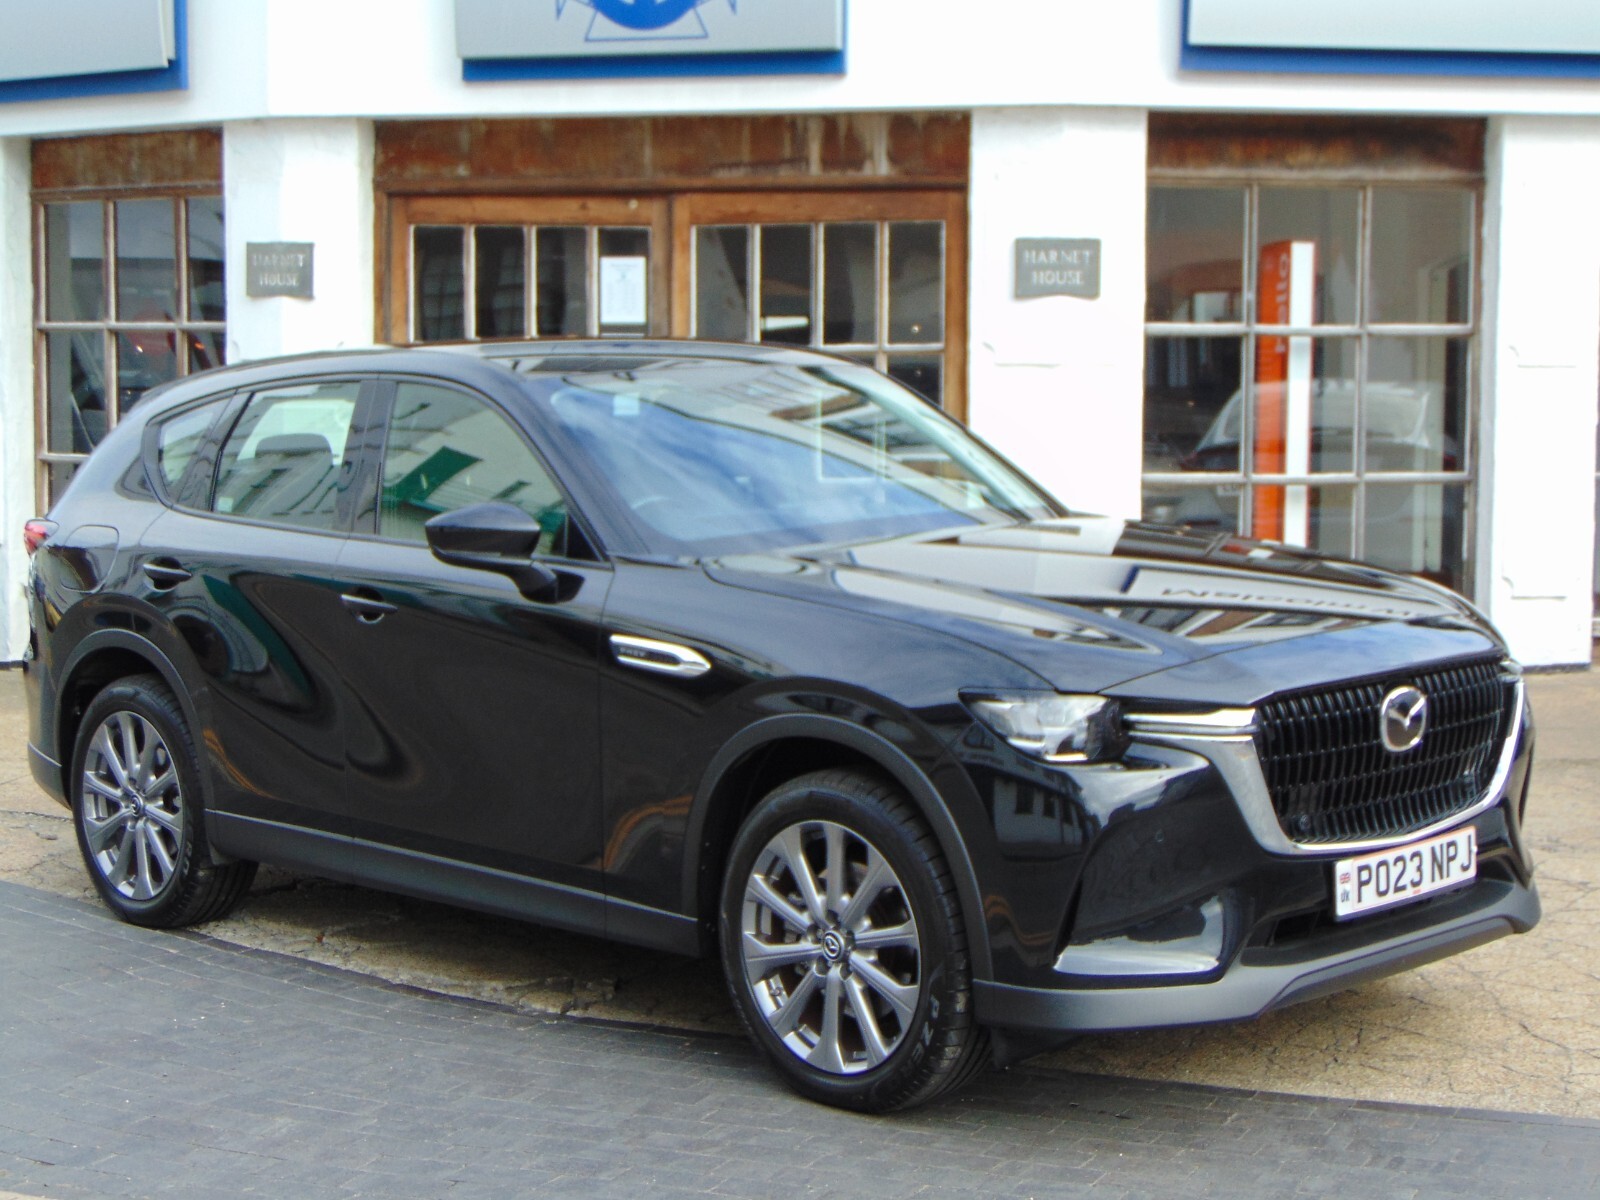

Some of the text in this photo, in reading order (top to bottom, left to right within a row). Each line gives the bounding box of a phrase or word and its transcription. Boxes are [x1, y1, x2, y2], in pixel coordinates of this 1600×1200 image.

[1023, 249, 1092, 264] HARNET
[1031, 269, 1085, 286] HOUSE
[1430, 834, 1473, 883] NPJ
